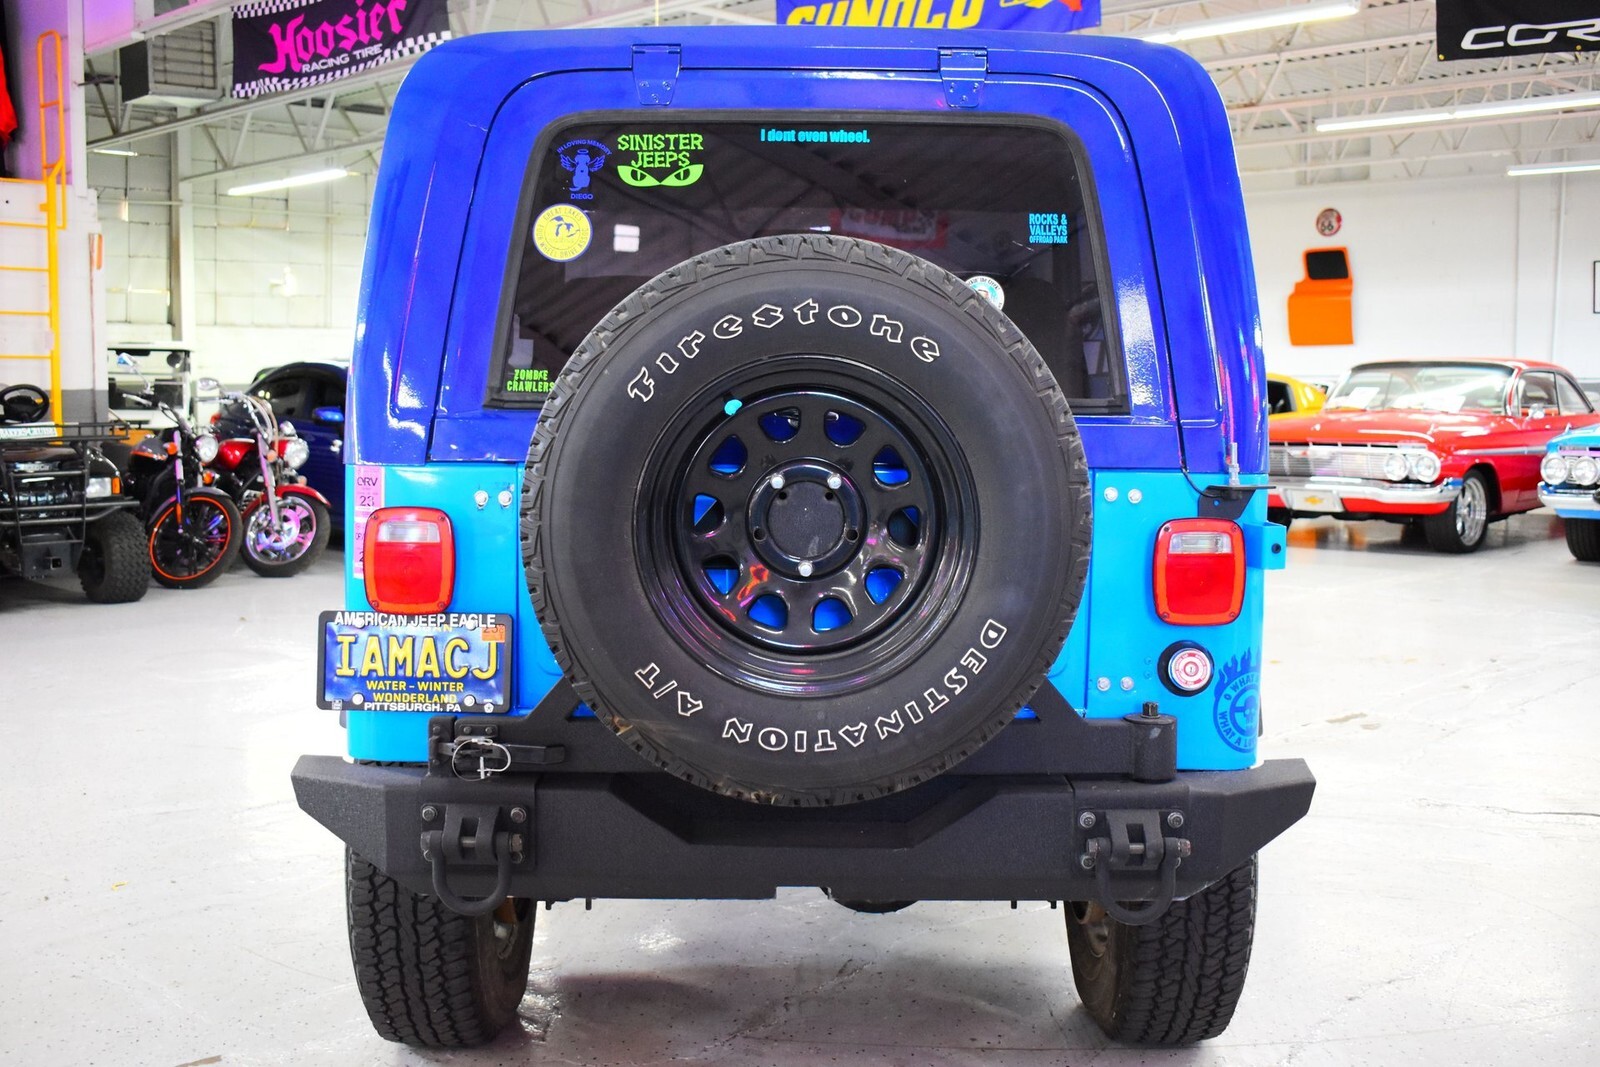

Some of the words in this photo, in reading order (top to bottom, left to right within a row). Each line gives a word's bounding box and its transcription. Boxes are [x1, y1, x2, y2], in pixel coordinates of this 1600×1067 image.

[258, 0, 407, 73] Hoosier
[302, 55, 350, 73] RACING
[353, 43, 383, 60] TIRE
[617, 134, 704, 151] SINISTER
[760, 129, 766, 142] I
[767, 129, 796, 142] dont
[798, 131, 828, 143] even
[829, 129, 871, 143] wheel.
[563, 139, 587, 150] LOVING
[587, 139, 612, 156] MEMORY
[631, 151, 690, 168] JEEPS
[1029, 213, 1059, 225] ROCKS
[1060, 213, 1068, 225] &
[1029, 225, 1068, 236] VALLEYS
[1029, 235, 1053, 244] OFFROAD
[1054, 236, 1068, 244] PARK
[627, 298, 940, 402] Firestone
[506, 380, 556, 393] CRAWLERS
[357, 477, 378, 487] ORV
[334, 611, 408, 627] AMERICAN
[410, 613, 445, 628] JEEP
[451, 613, 496, 628] EAGLE
[335, 633, 498, 681] IAMACJ
[366, 680, 406, 691] WATER
[417, 680, 464, 692] WINTER
[635, 662, 704, 717] A/T
[722, 618, 1008, 753] DESTINATION
[1230, 673, 1255, 693] WHAT
[373, 692, 457, 704] WONDERLAND
[446, 703, 462, 713] PA
[1218, 710, 1235, 741] WHAT
[1234, 737, 1242, 747] A
